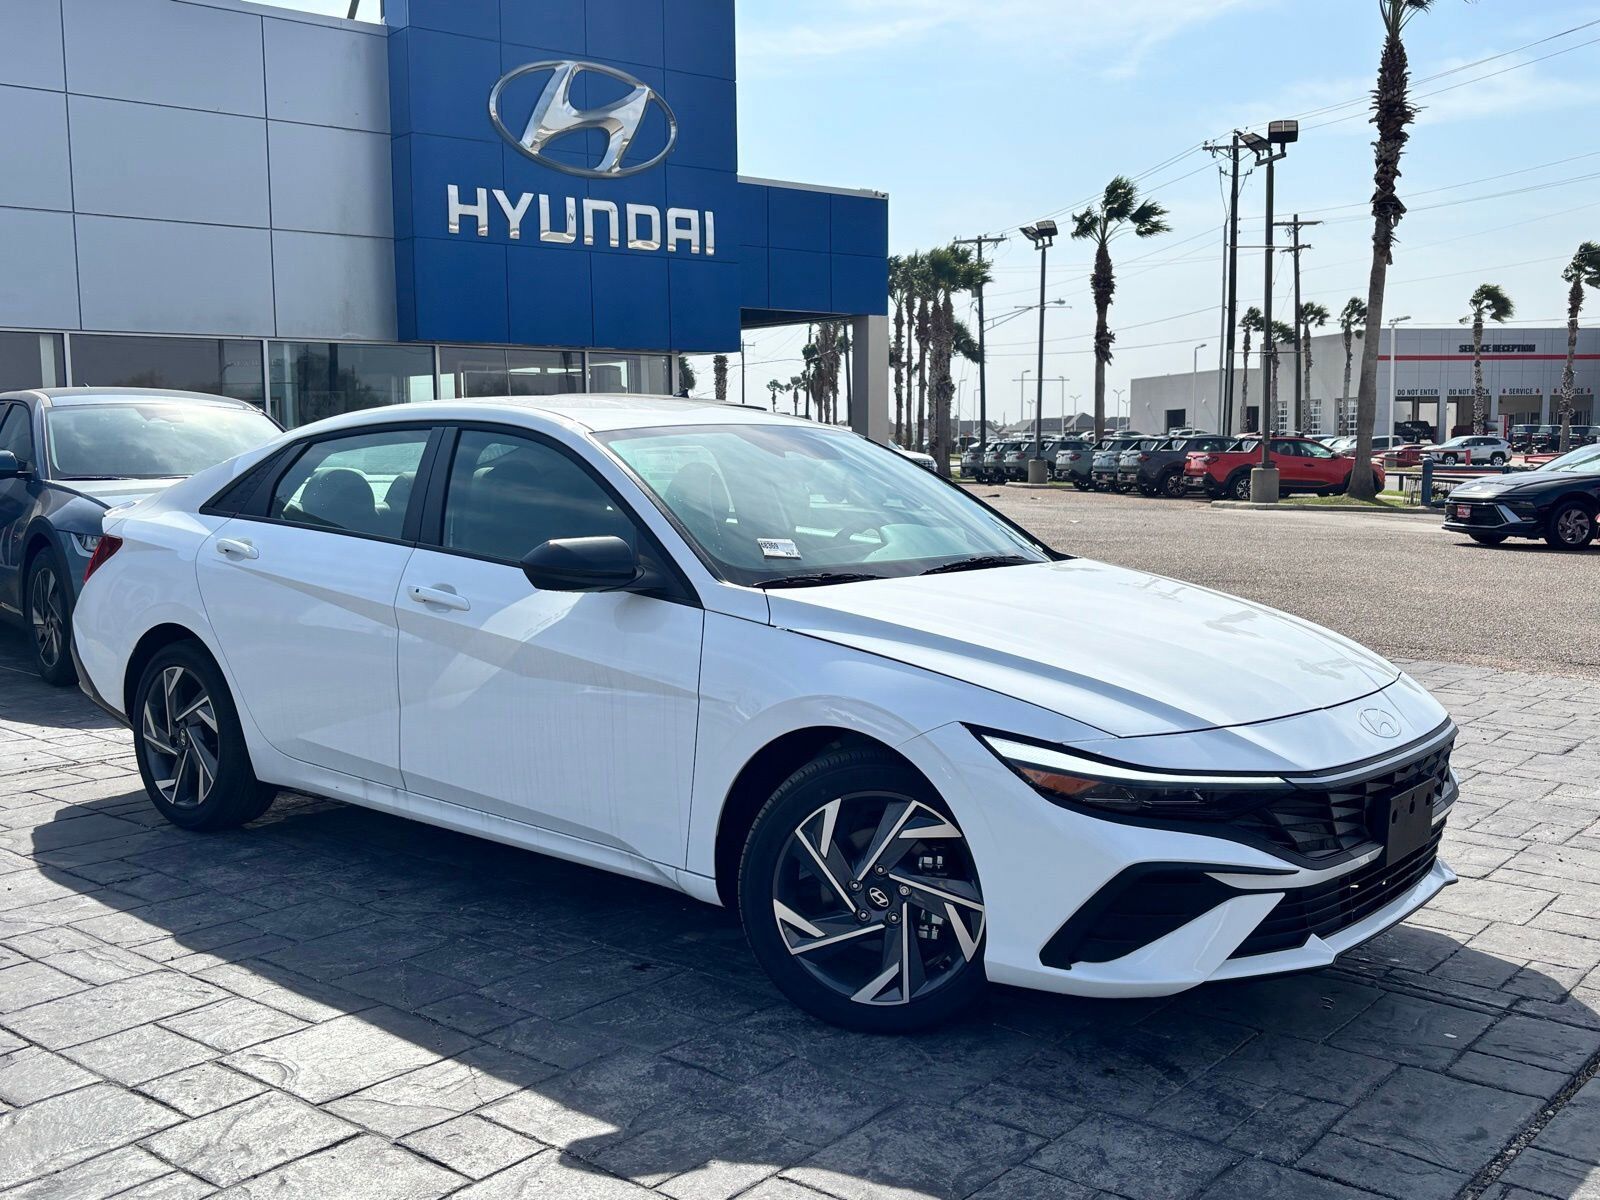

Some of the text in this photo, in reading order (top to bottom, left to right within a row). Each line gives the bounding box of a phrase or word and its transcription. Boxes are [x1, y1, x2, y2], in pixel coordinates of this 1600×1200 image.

[447, 184, 715, 256] HYUNDAI
[1458, 344, 1536, 352] SERICE RECEPTION
[1407, 388, 1419, 396] NOT
